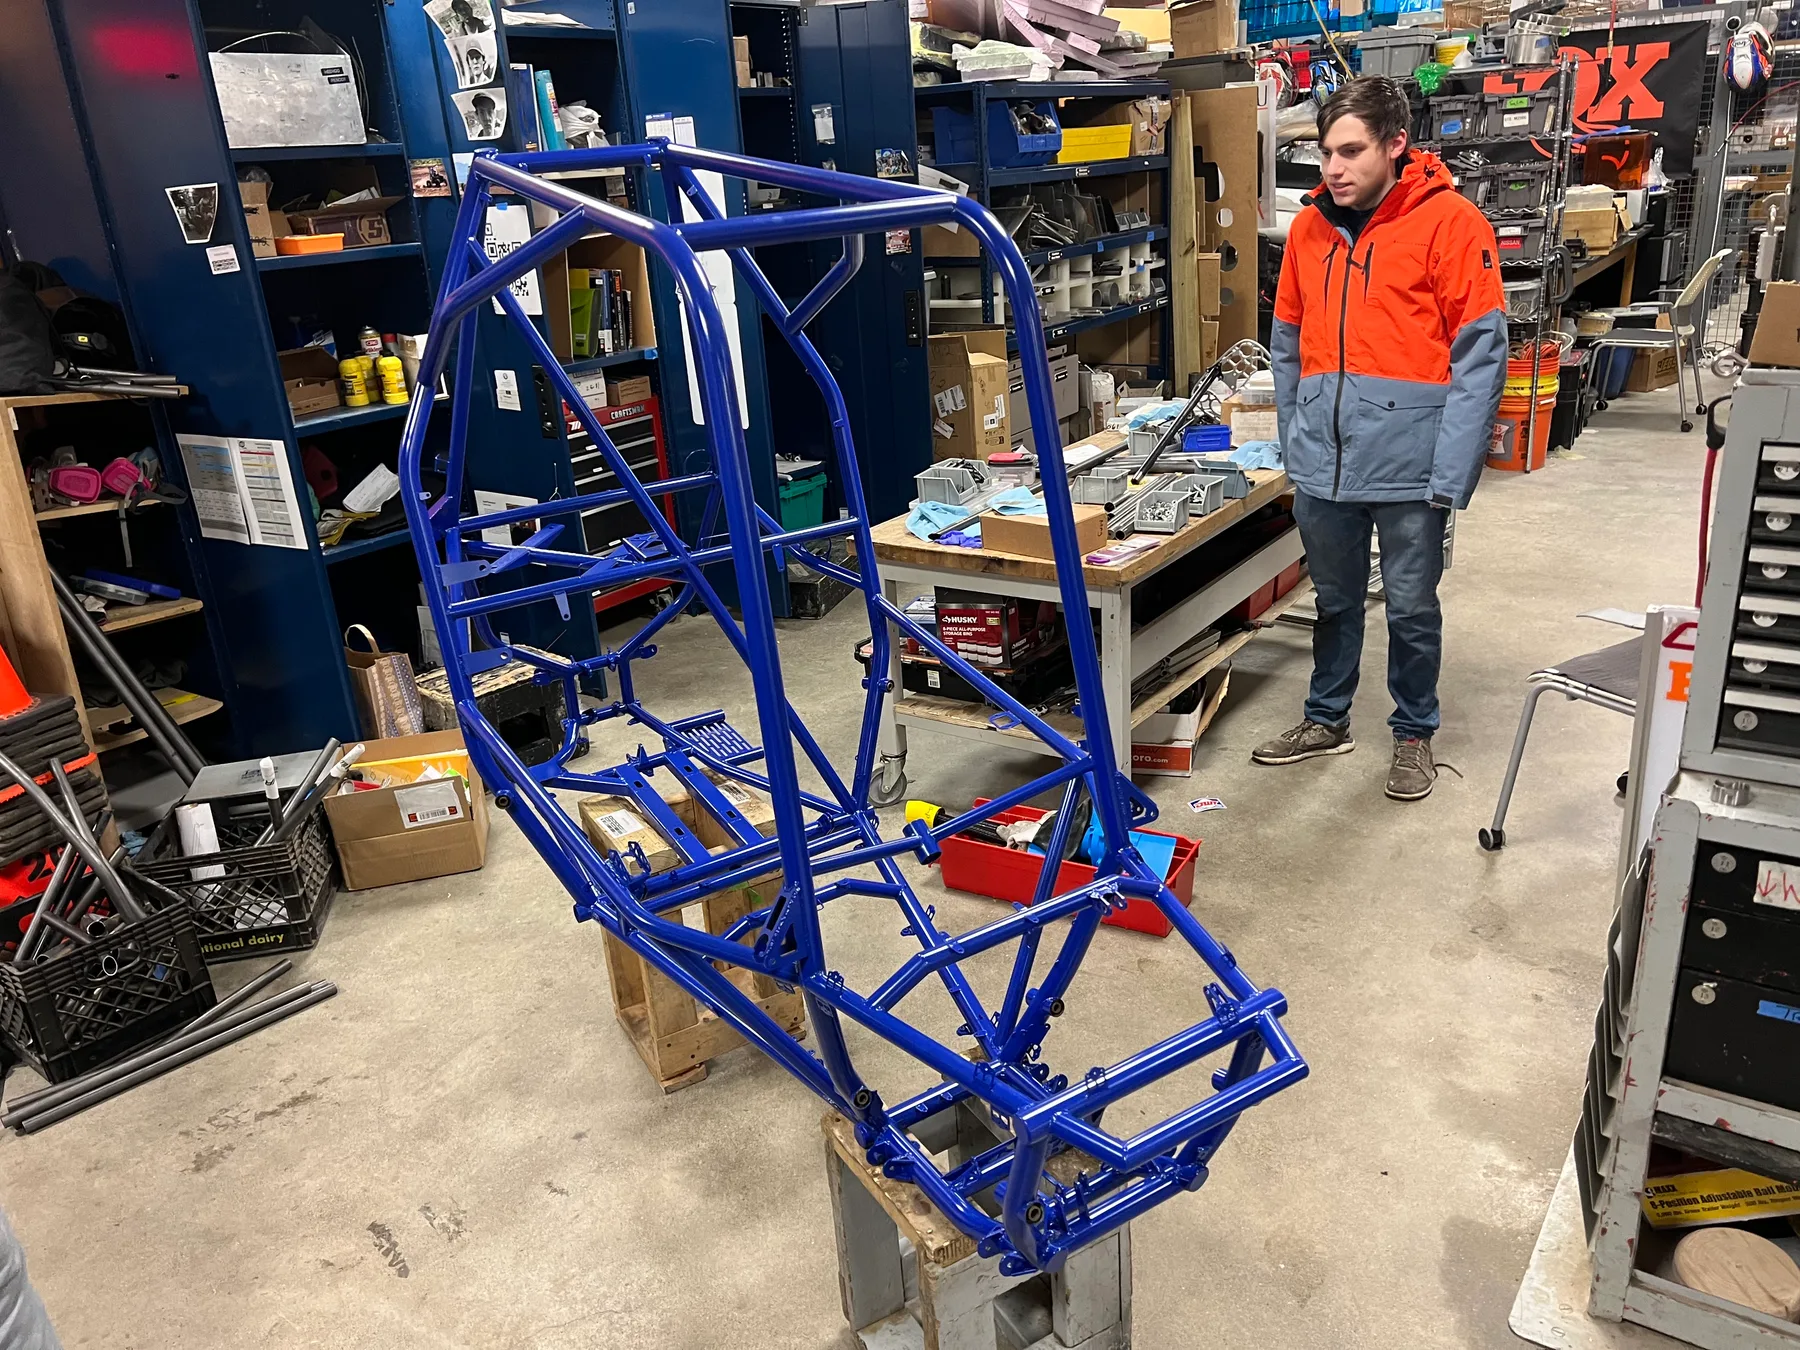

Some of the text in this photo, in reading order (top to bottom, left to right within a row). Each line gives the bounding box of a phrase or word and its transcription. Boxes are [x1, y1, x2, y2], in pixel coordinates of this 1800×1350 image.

[1483, 42, 1670, 122] OX
[610, 404, 645, 420] CRAFTSMAN
[1132, 754, 1169, 764] oro.com
[201, 933, 284, 953] tional dairy
[1649, 1196, 1700, 1210] 8-Position
[1699, 1190, 1753, 1204] Adjustable
[1754, 1185, 1776, 1197] Ball
